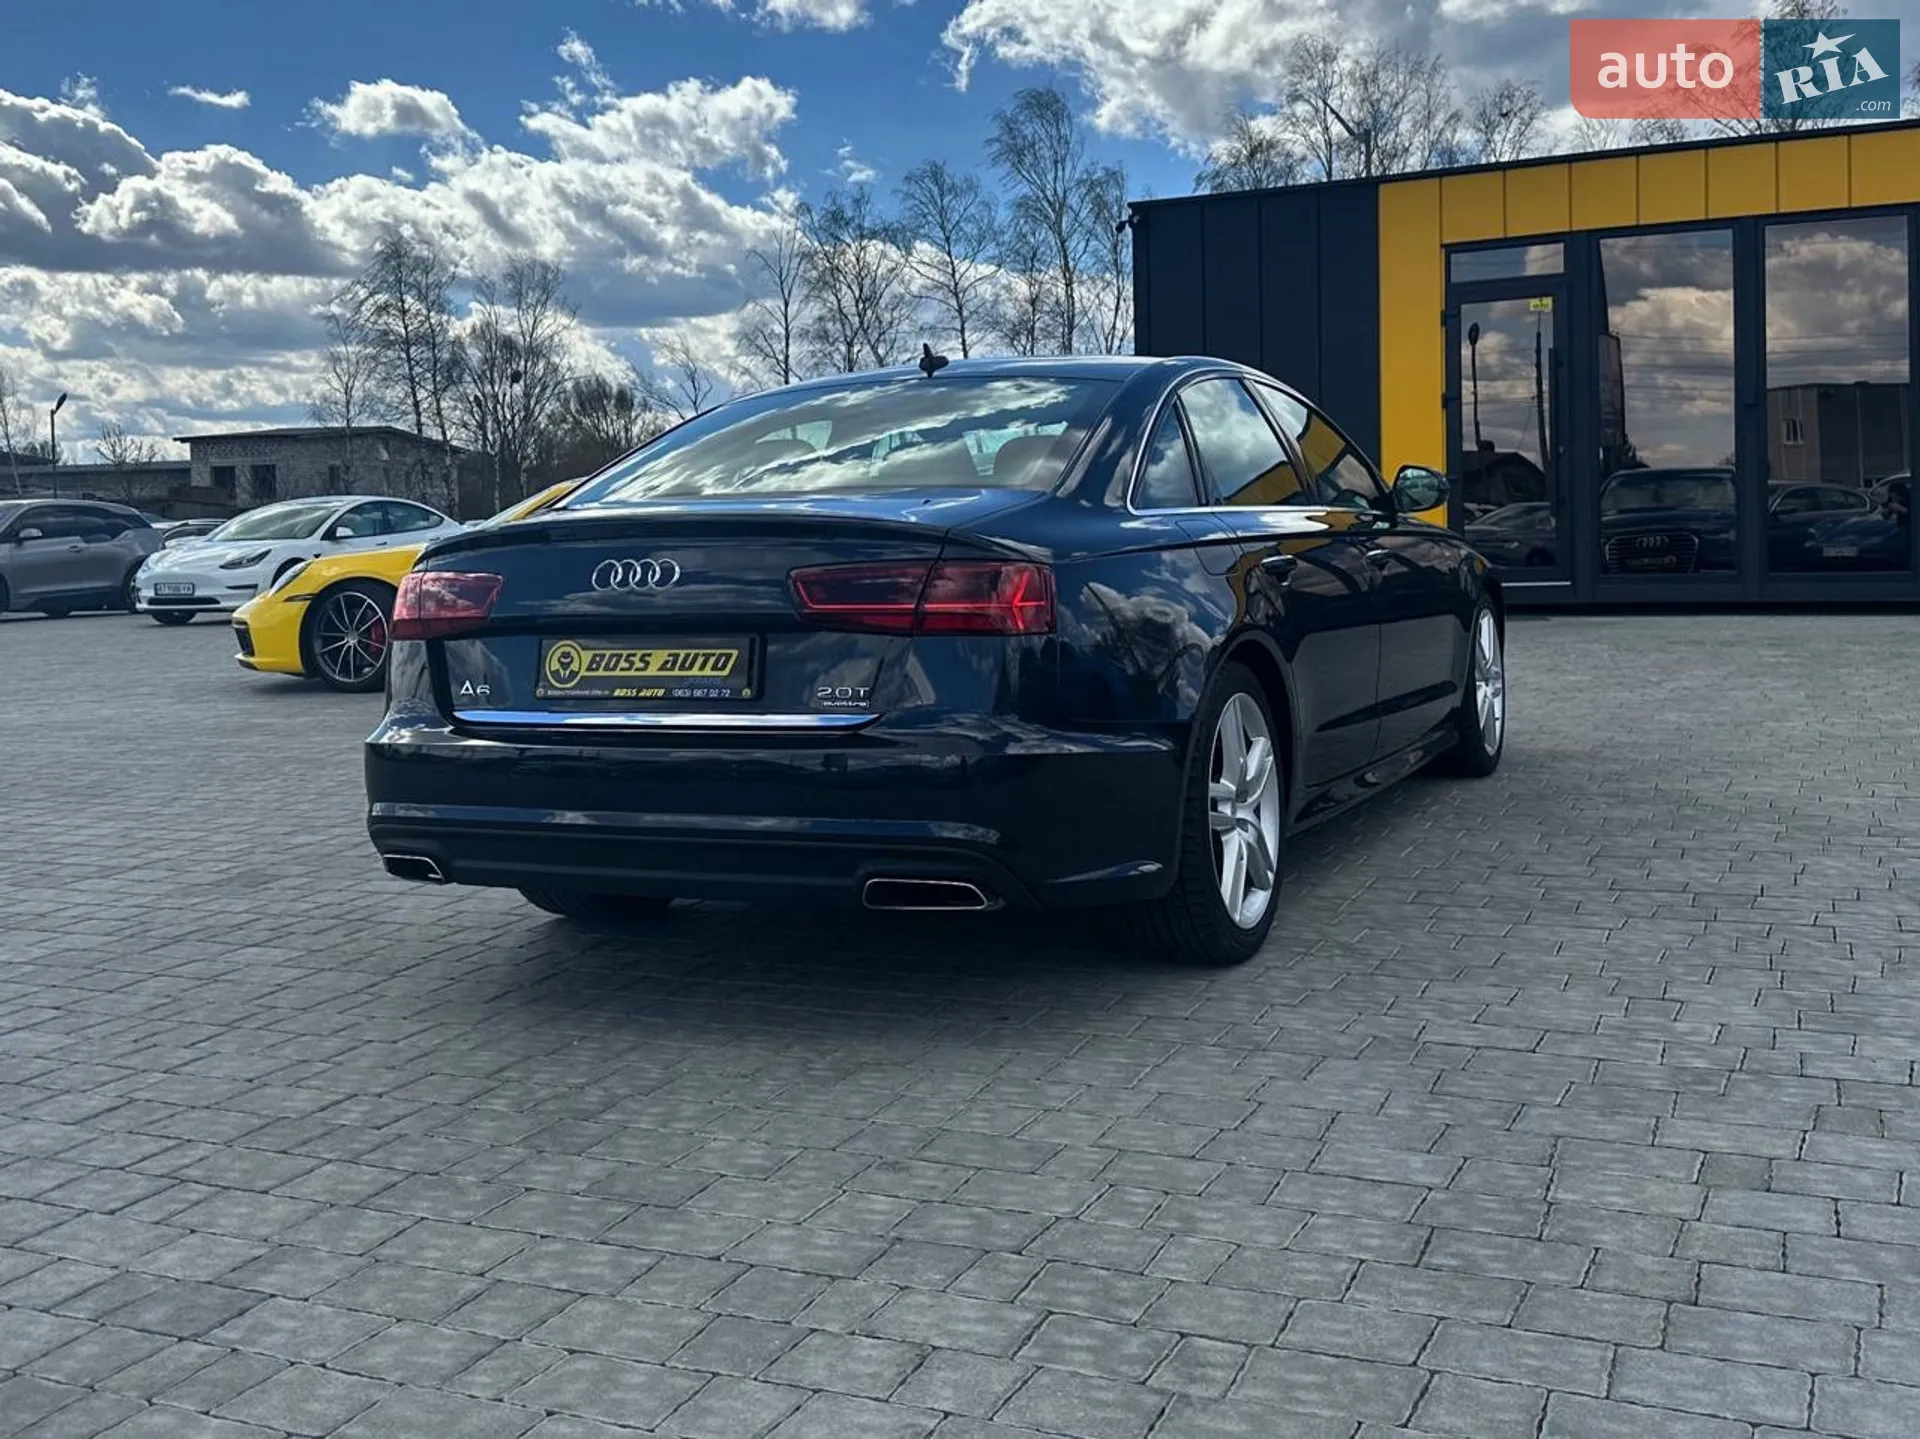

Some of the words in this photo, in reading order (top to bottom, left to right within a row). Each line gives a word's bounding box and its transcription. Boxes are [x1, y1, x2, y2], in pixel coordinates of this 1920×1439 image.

[585, 652, 652, 672] BOSS
[657, 652, 733, 672] AUTO
[460, 679, 490, 697] A6
[613, 688, 637, 697] BOSS
[638, 688, 665, 697] AUTO
